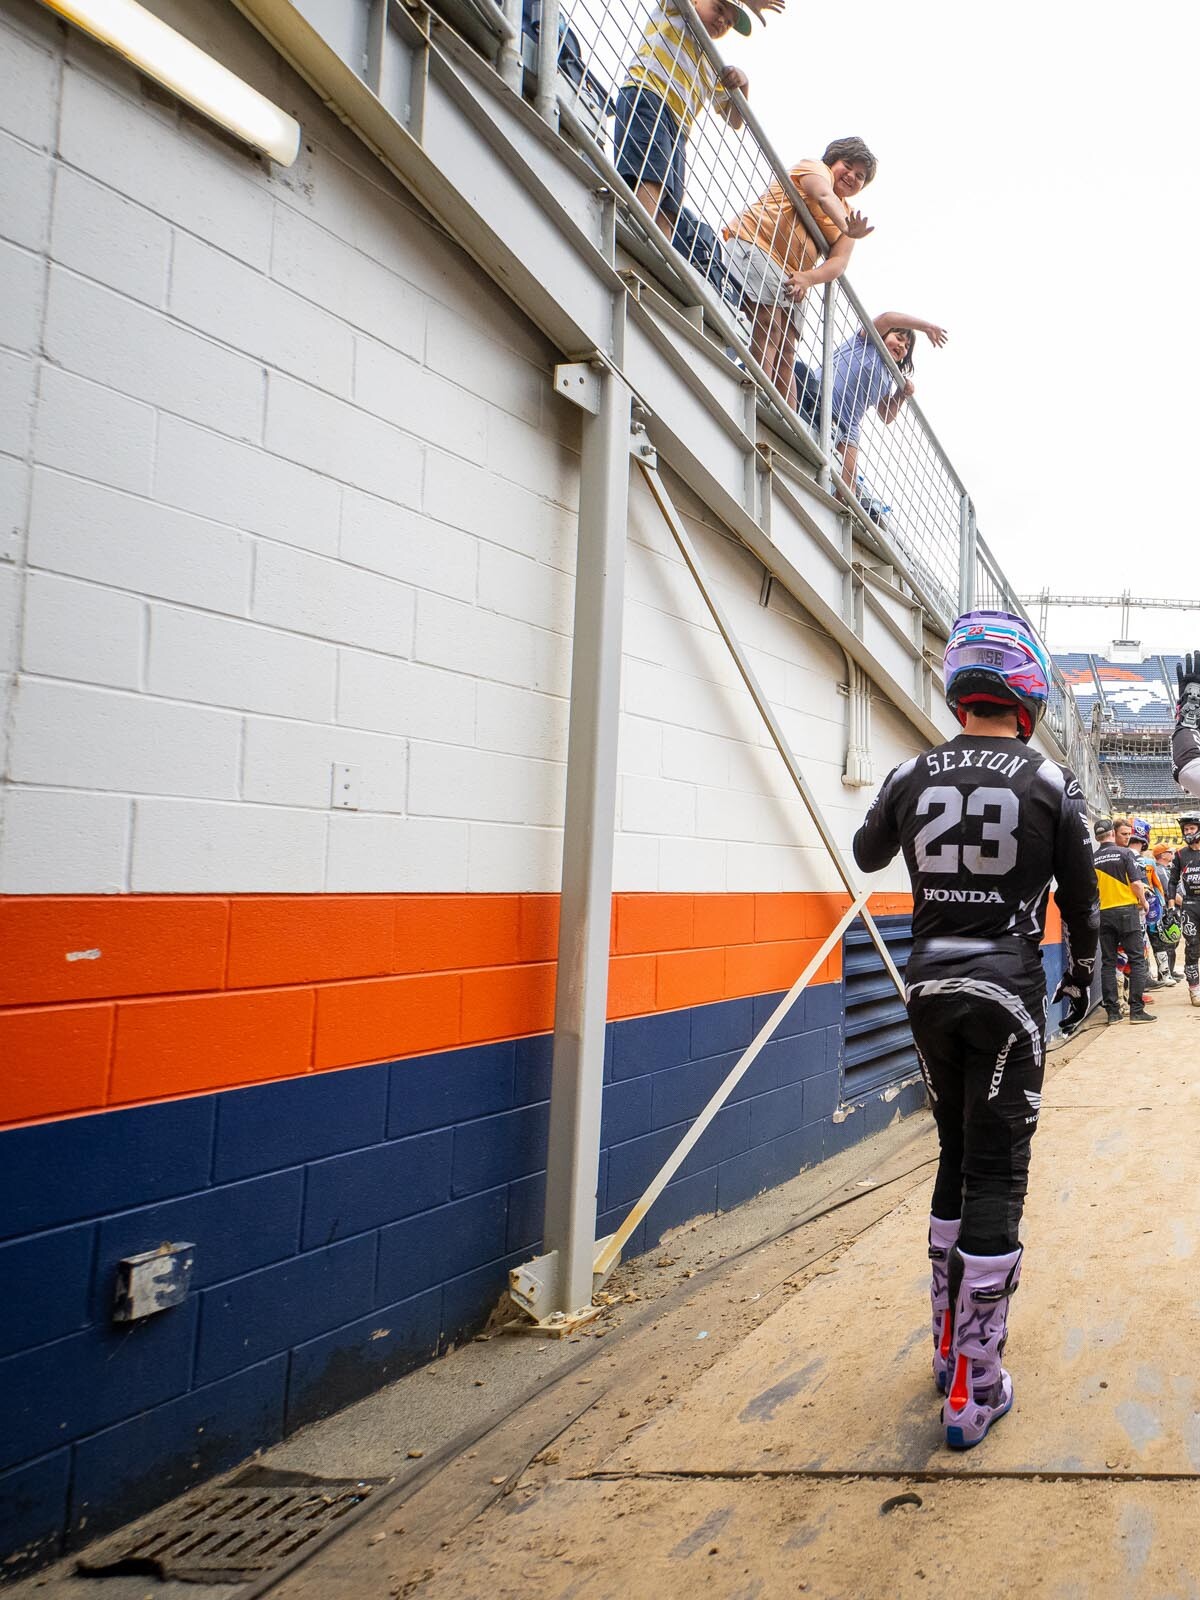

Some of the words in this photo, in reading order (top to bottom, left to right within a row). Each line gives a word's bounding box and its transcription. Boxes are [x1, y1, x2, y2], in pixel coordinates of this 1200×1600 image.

[968, 626, 985, 636] 23
[926, 750, 1028, 780] SEXTON
[914, 785, 1019, 875] 23
[923, 888, 1005, 904] HONDA
